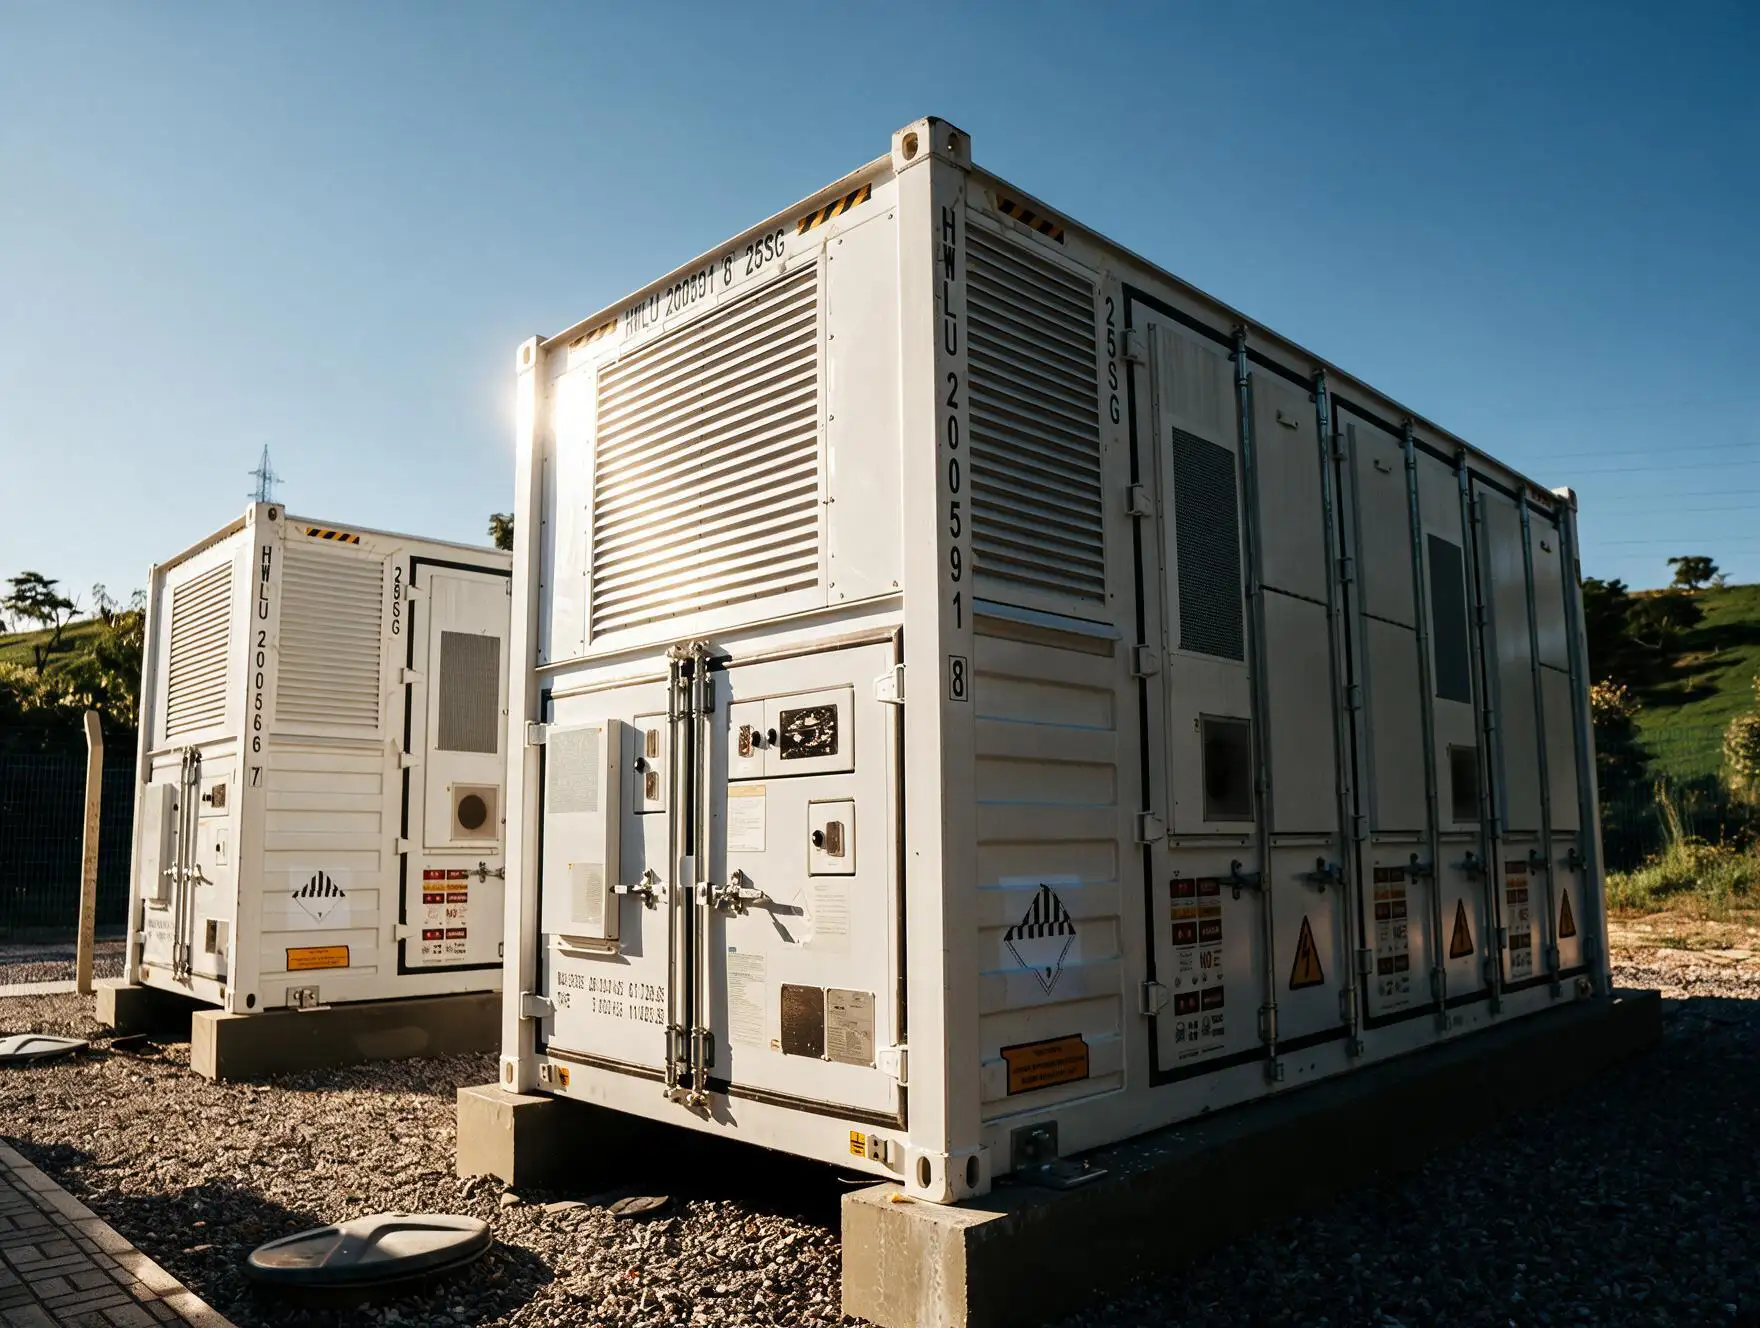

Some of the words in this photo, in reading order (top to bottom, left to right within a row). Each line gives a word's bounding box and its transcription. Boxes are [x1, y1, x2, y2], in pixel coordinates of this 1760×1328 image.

[723, 256, 733, 286] 8
[745, 228, 785, 276] 25SG
[942, 206, 957, 356] HWLU
[1105, 296, 1120, 425] 25SG
[946, 372, 962, 629] 200591
[259, 545, 272, 620] HWLU
[952, 660, 964, 697] 8
[251, 766, 260, 786] 7
